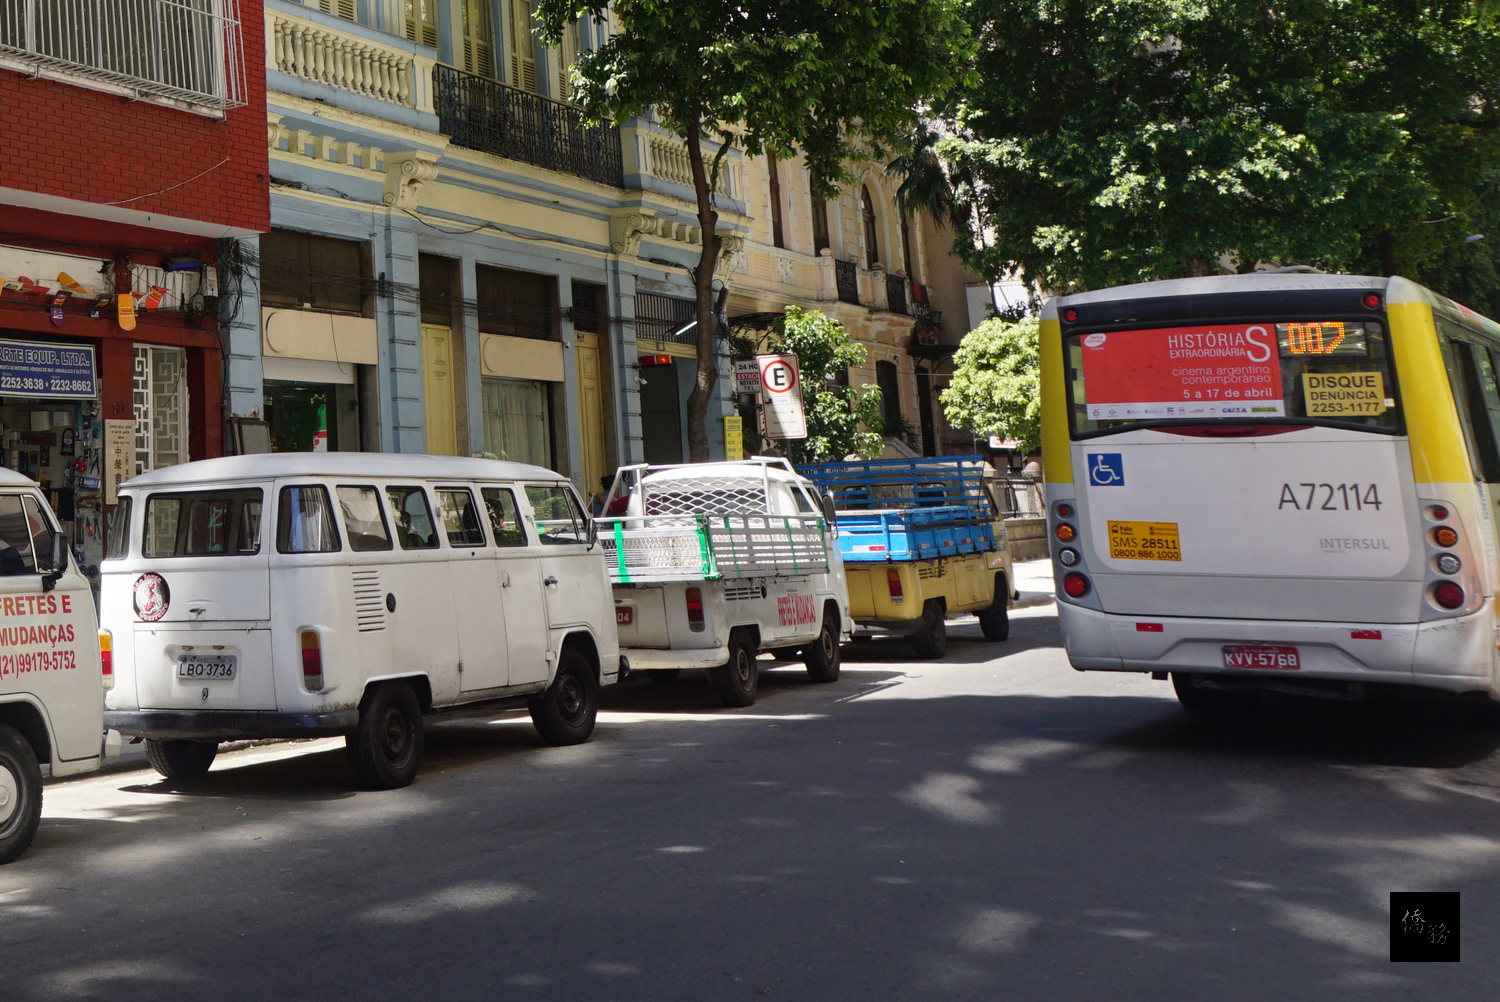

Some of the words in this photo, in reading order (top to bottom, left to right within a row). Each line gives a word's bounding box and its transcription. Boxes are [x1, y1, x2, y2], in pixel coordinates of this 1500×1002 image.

[25, 349, 60, 366] EQUIP.
[61, 351, 90, 367] LTDA.
[773, 367, 785, 386] E
[1172, 366, 1212, 376] cinema
[1216, 365, 1270, 377] argentino
[1, 376, 44, 390] 2252-3638
[51, 379, 92, 392] 2232-8662
[1181, 374, 1271, 385] contemporâneo
[1309, 376, 1377, 388] DISQUE
[1183, 389, 1190, 398] 5
[1206, 389, 1220, 398] 17
[1224, 388, 1240, 397] de
[1244, 388, 1273, 397] abril
[1310, 389, 1378, 401] DENÚNCIA
[1311, 402, 1380, 413] 2253-1177
[1277, 483, 1382, 511] A72114
[1112, 537, 1138, 547] SMS
[1141, 538, 1178, 549] 28511
[1319, 538, 1391, 549] INTERSUL
[1113, 549, 1136, 557] 0800
[1137, 550, 1155, 558] 886
[1156, 551, 1179, 559] 1000
[61, 595, 72, 614] E
[0, 650, 76, 680] (21)99179-5752
[1225, 653, 1297, 666] KVV-5768
